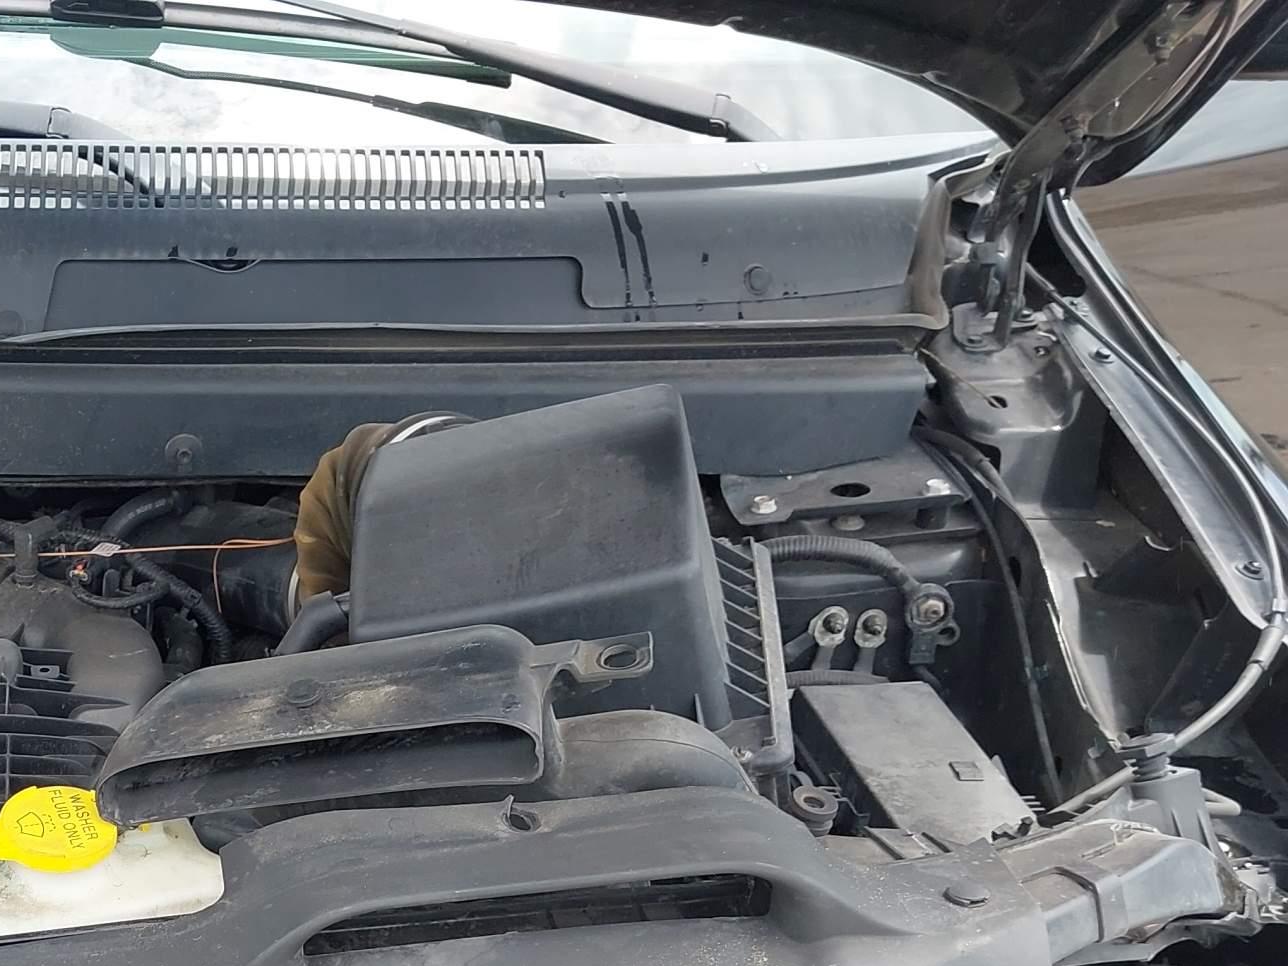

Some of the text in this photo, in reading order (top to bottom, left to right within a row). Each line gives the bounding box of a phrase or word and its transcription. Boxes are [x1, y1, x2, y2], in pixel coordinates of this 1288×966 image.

[47, 789, 86, 849] FLUID ONLY
[69, 793, 99, 841] WASHER
